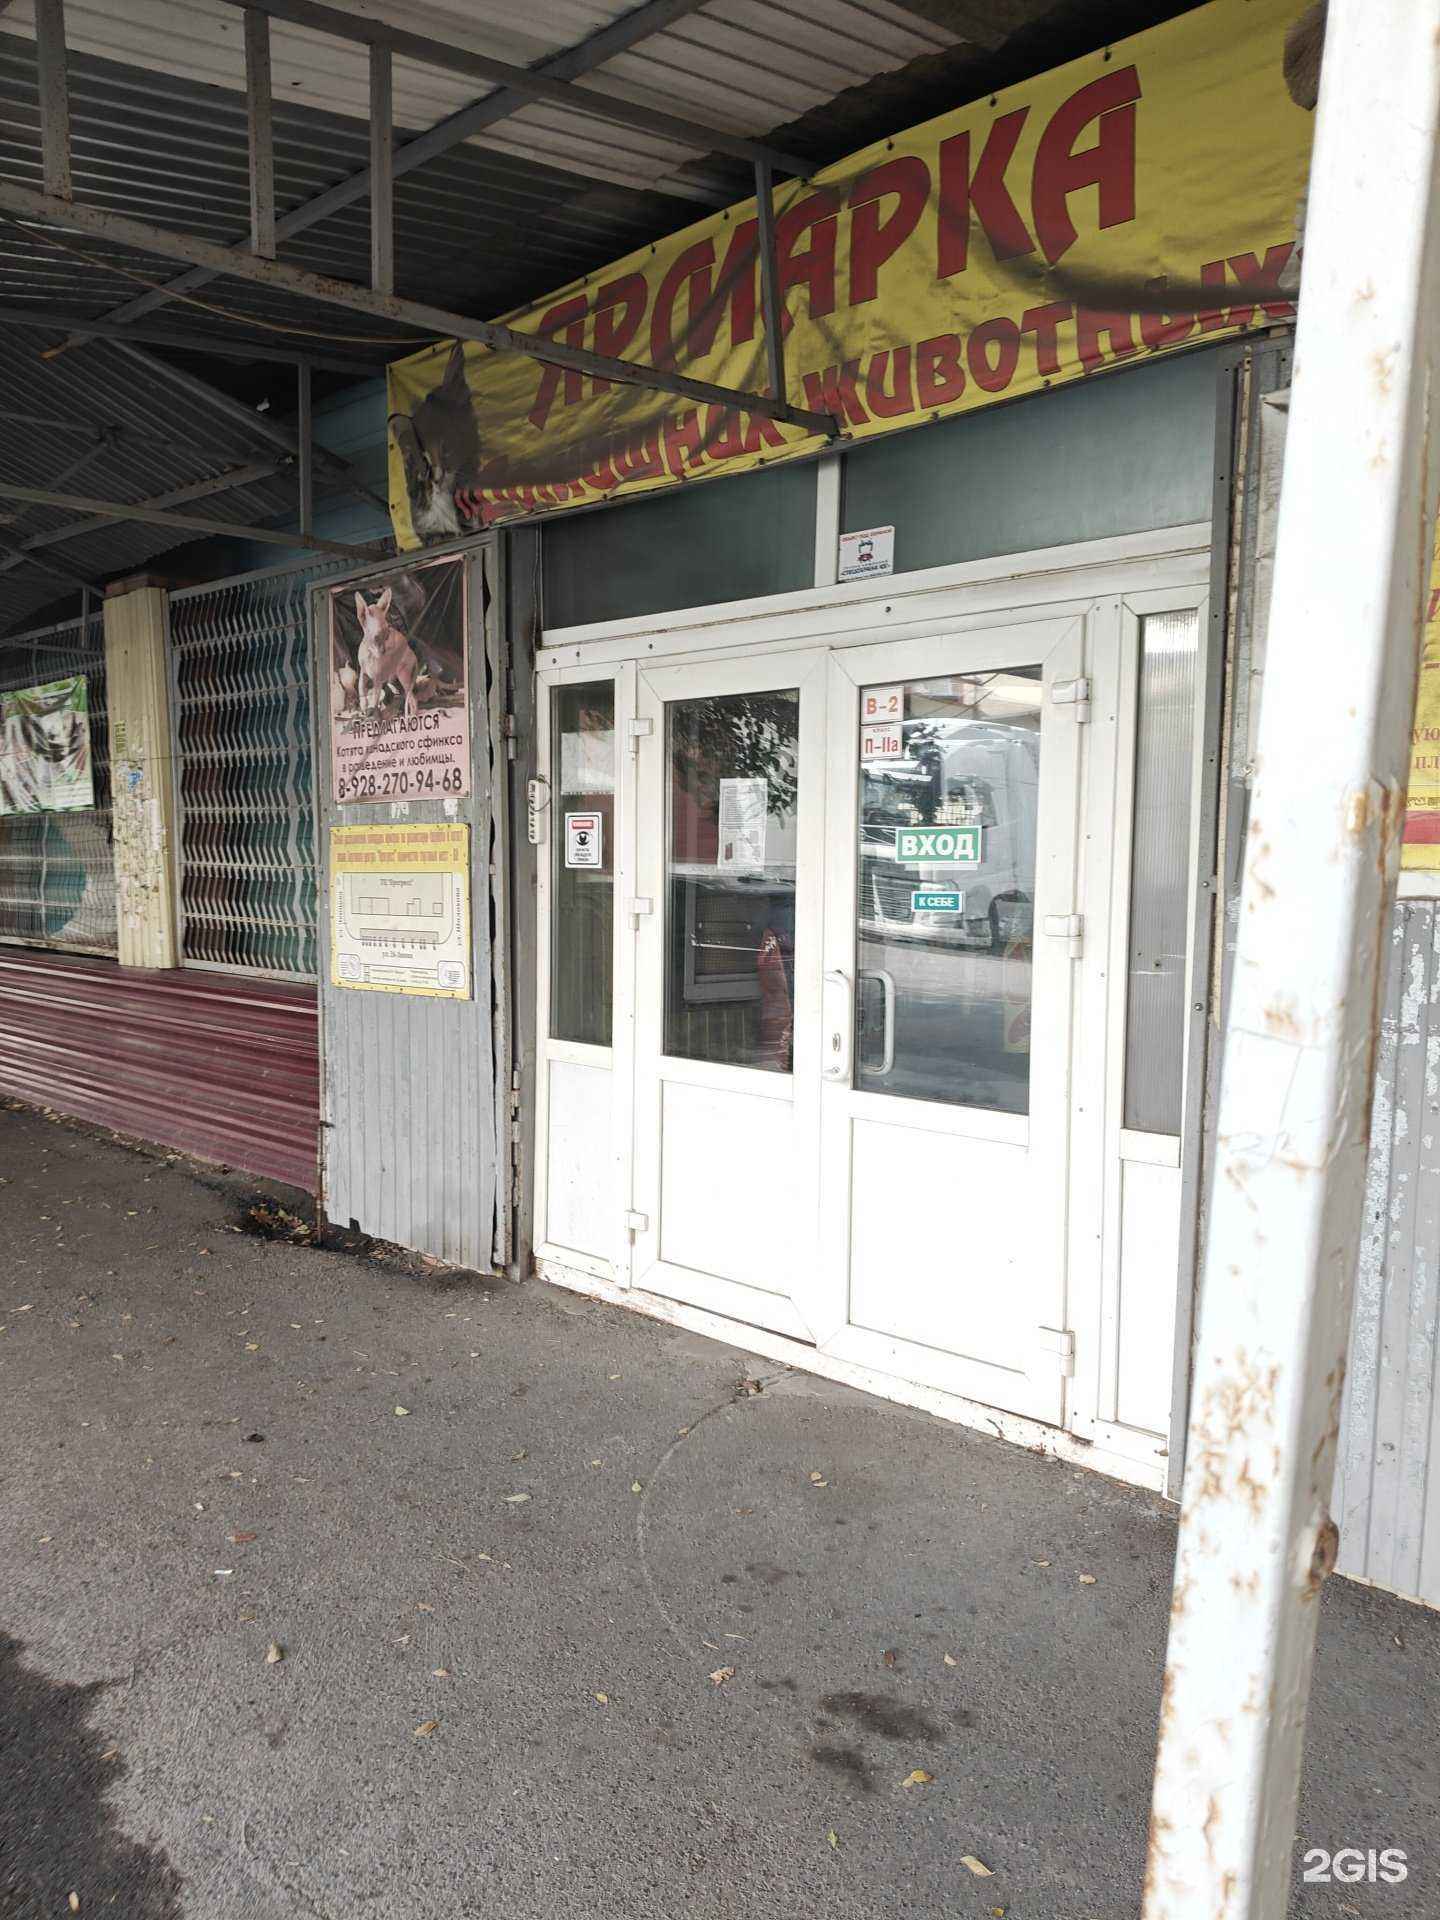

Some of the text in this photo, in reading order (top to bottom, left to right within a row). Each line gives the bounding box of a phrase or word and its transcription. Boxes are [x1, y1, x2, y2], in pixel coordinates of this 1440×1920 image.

[527, 63, 1142, 431] ЯРМАРКА
[802, 241, 1298, 437] ЖИВОТНЫХ
[337, 766, 463, 799] 8-928-270-94-68
[901, 833, 975, 860] ВХОД
